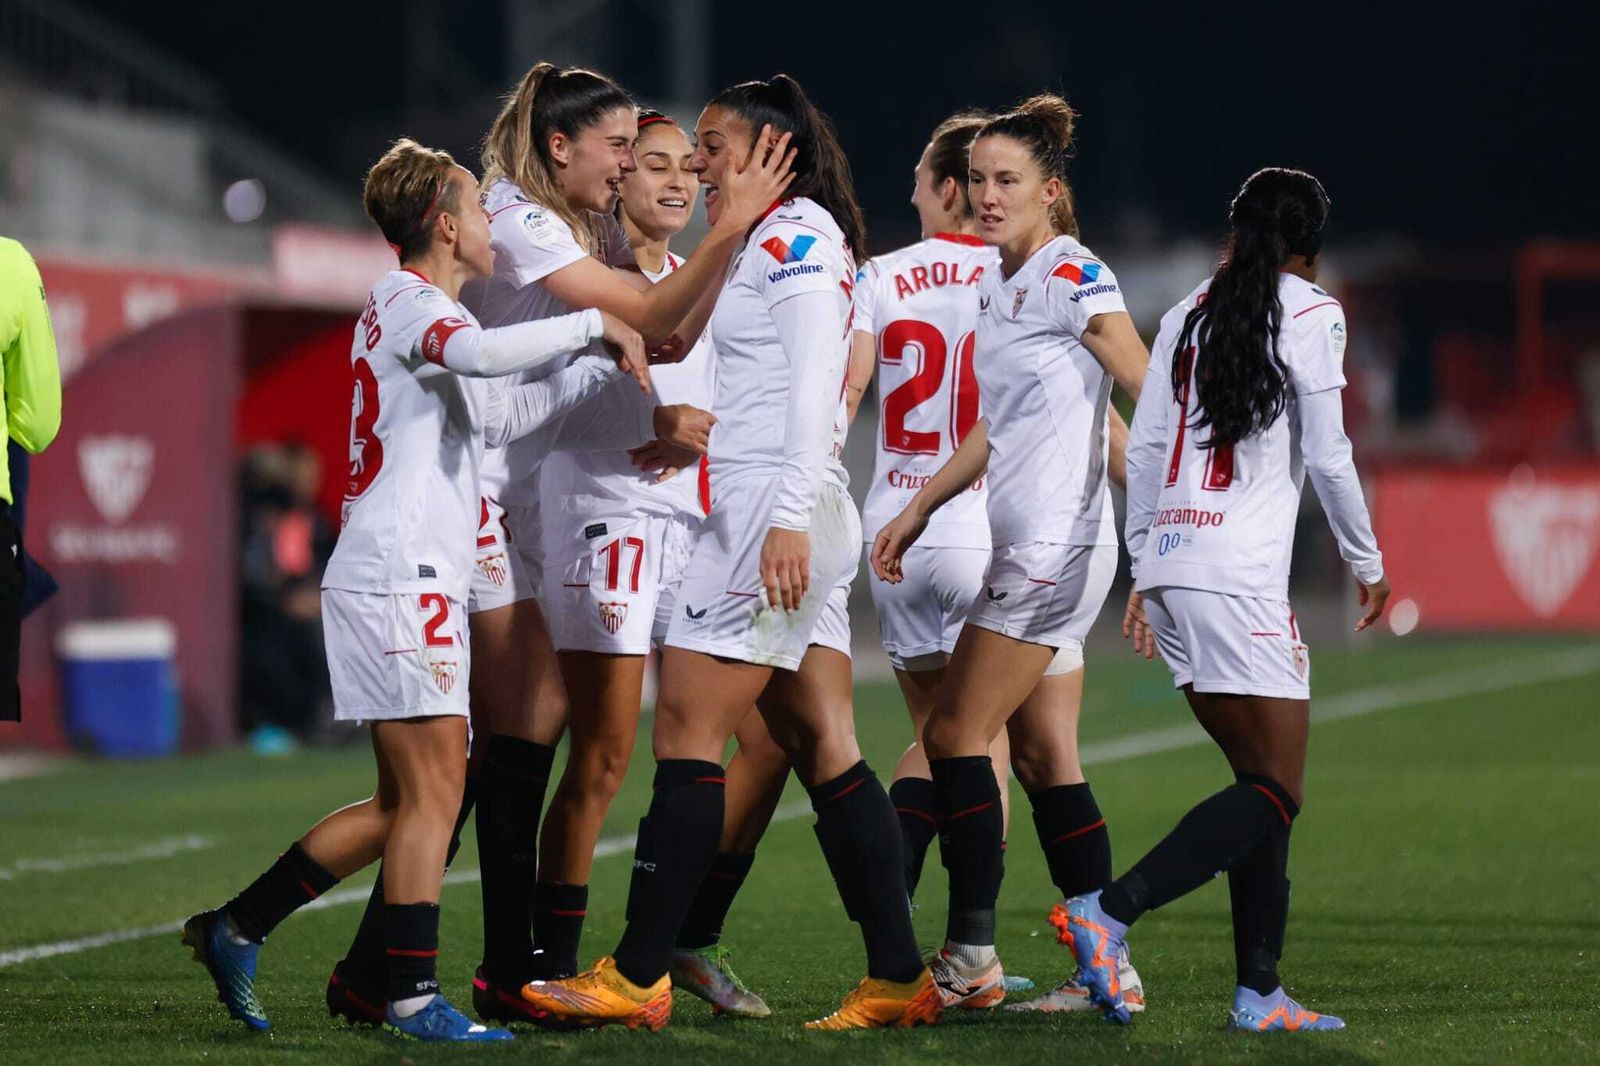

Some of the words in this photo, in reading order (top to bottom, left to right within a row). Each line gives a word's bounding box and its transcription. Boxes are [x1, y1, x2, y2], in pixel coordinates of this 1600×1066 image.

[768, 264, 823, 283] Valvoline
[895, 261, 984, 301] AROLA
[1070, 284, 1117, 303] Valvoline
[598, 536, 645, 593] 17
[416, 980, 438, 991] SFC
